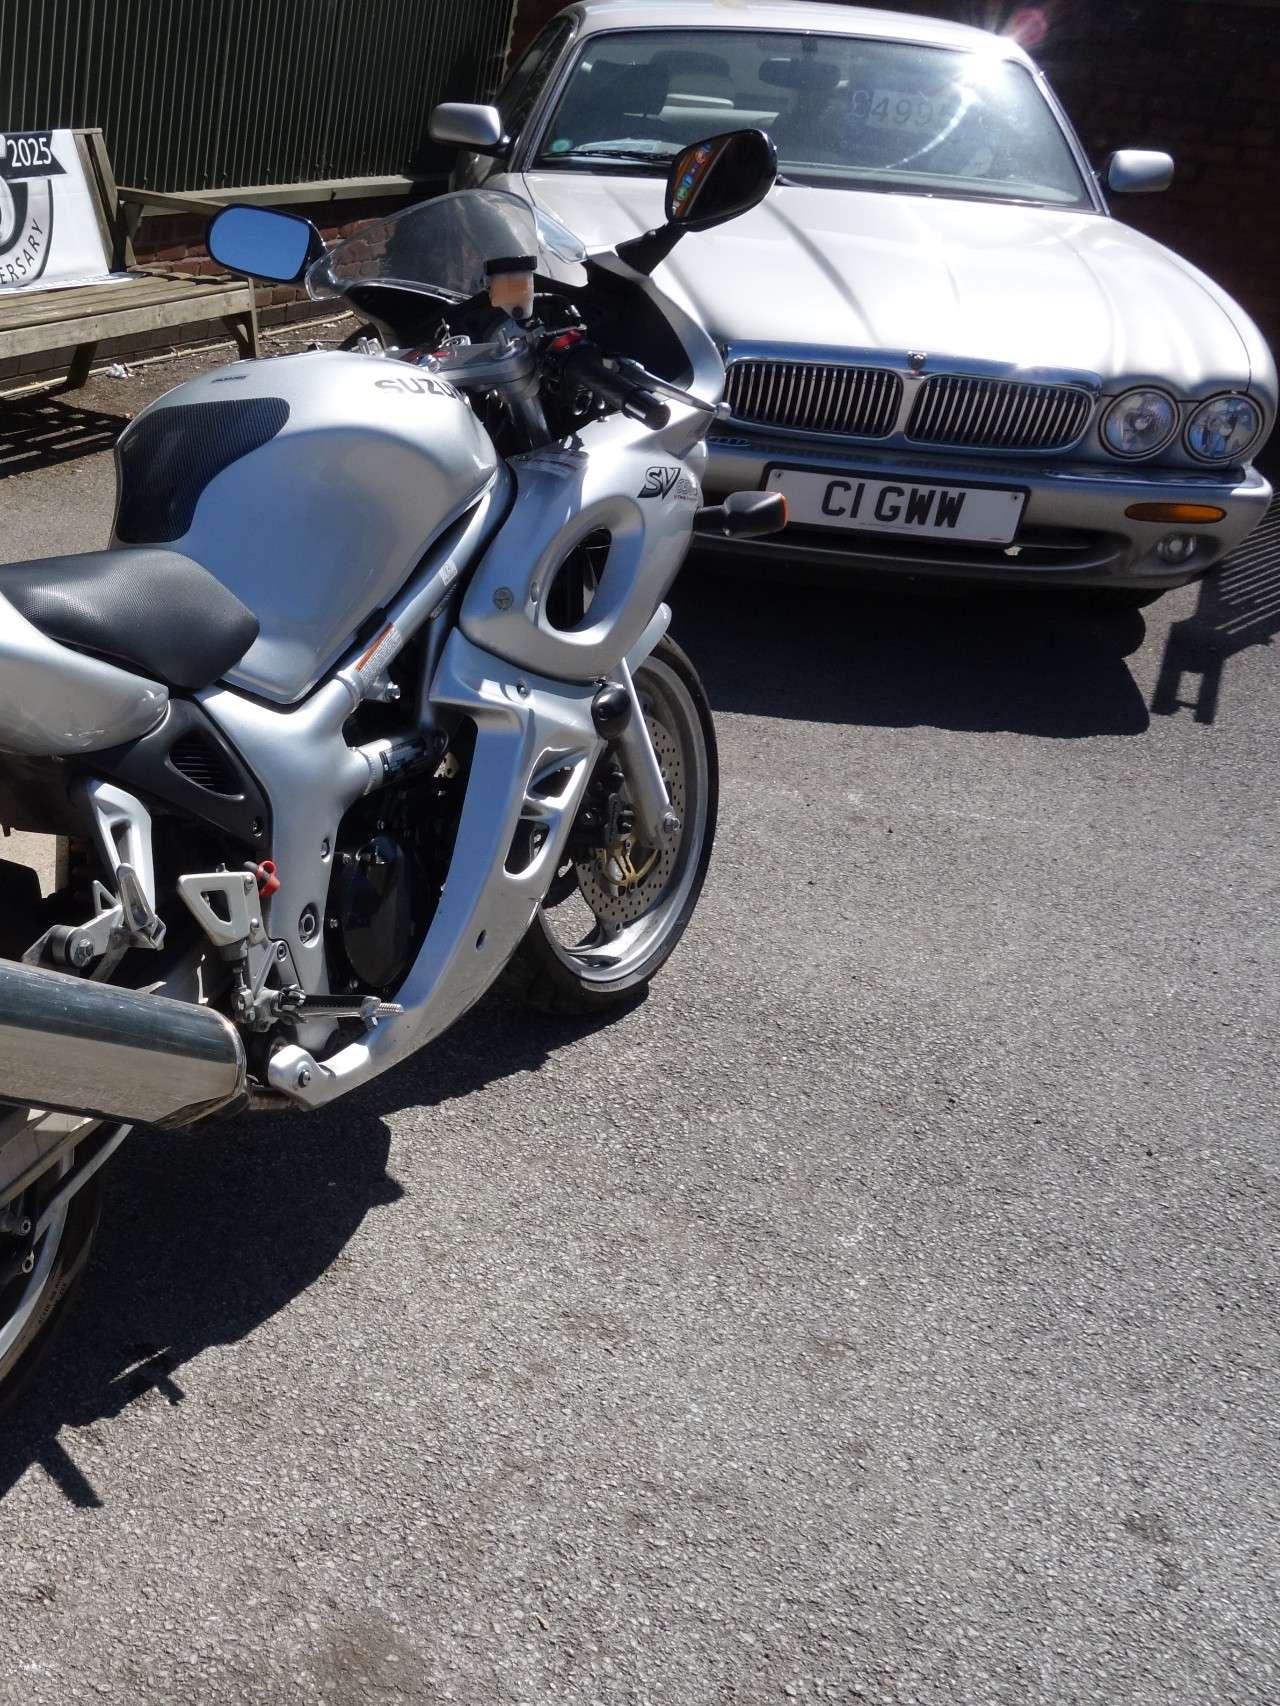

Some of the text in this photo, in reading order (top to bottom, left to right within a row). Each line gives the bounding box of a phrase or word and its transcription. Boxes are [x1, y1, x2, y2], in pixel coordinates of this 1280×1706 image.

[7, 137, 52, 168] 2025
[637, 466, 681, 500] SV
[874, 485, 966, 528] GWW
